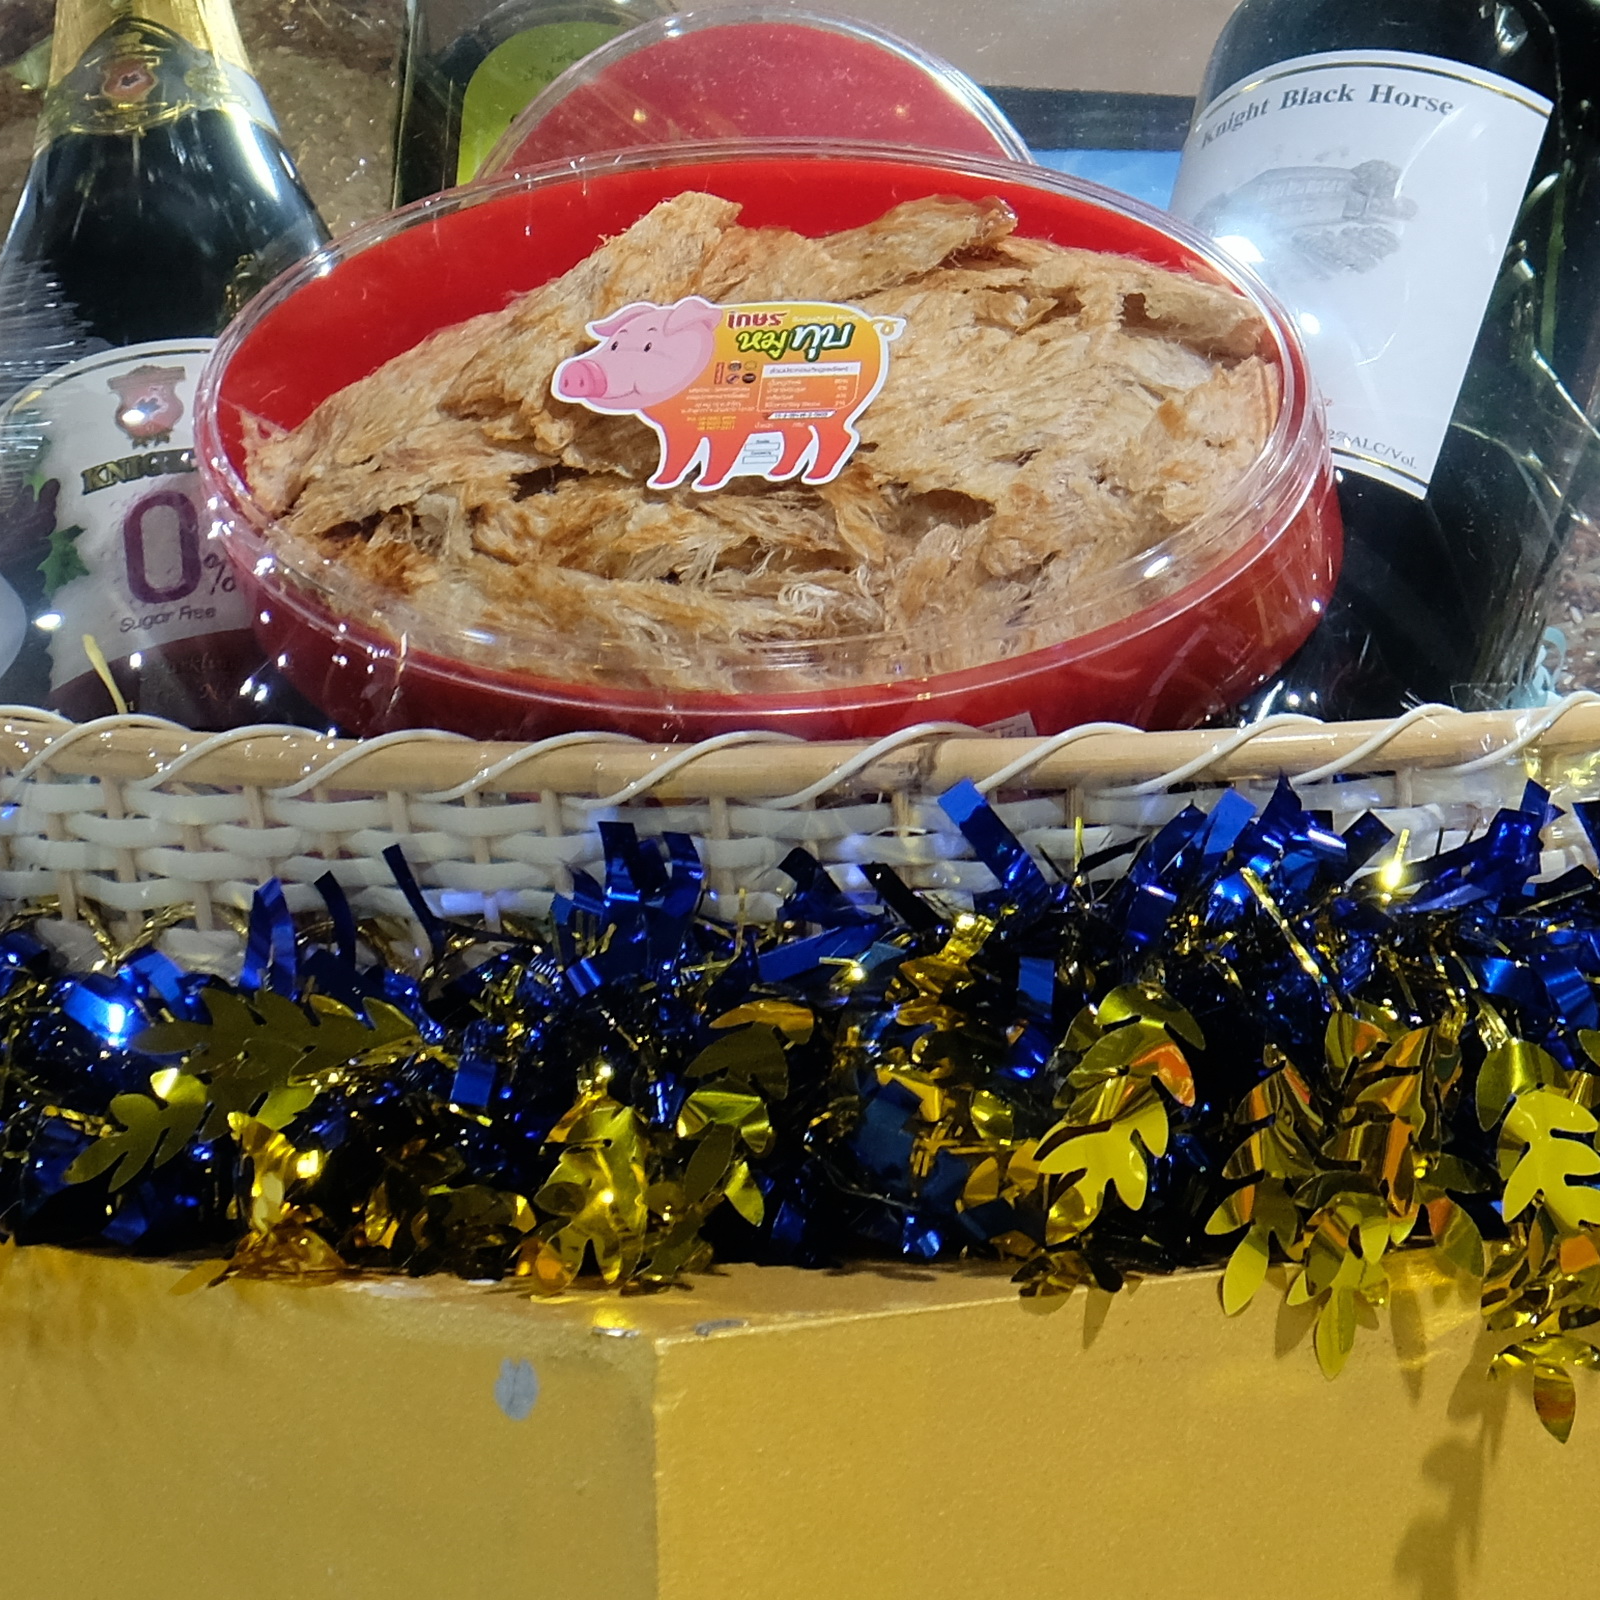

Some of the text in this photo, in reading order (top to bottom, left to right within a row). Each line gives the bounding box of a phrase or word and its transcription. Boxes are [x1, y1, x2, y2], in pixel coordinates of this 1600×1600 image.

[1201, 82, 1456, 148] Knight Black Horse
[119, 605, 218, 633] Sugar Free
